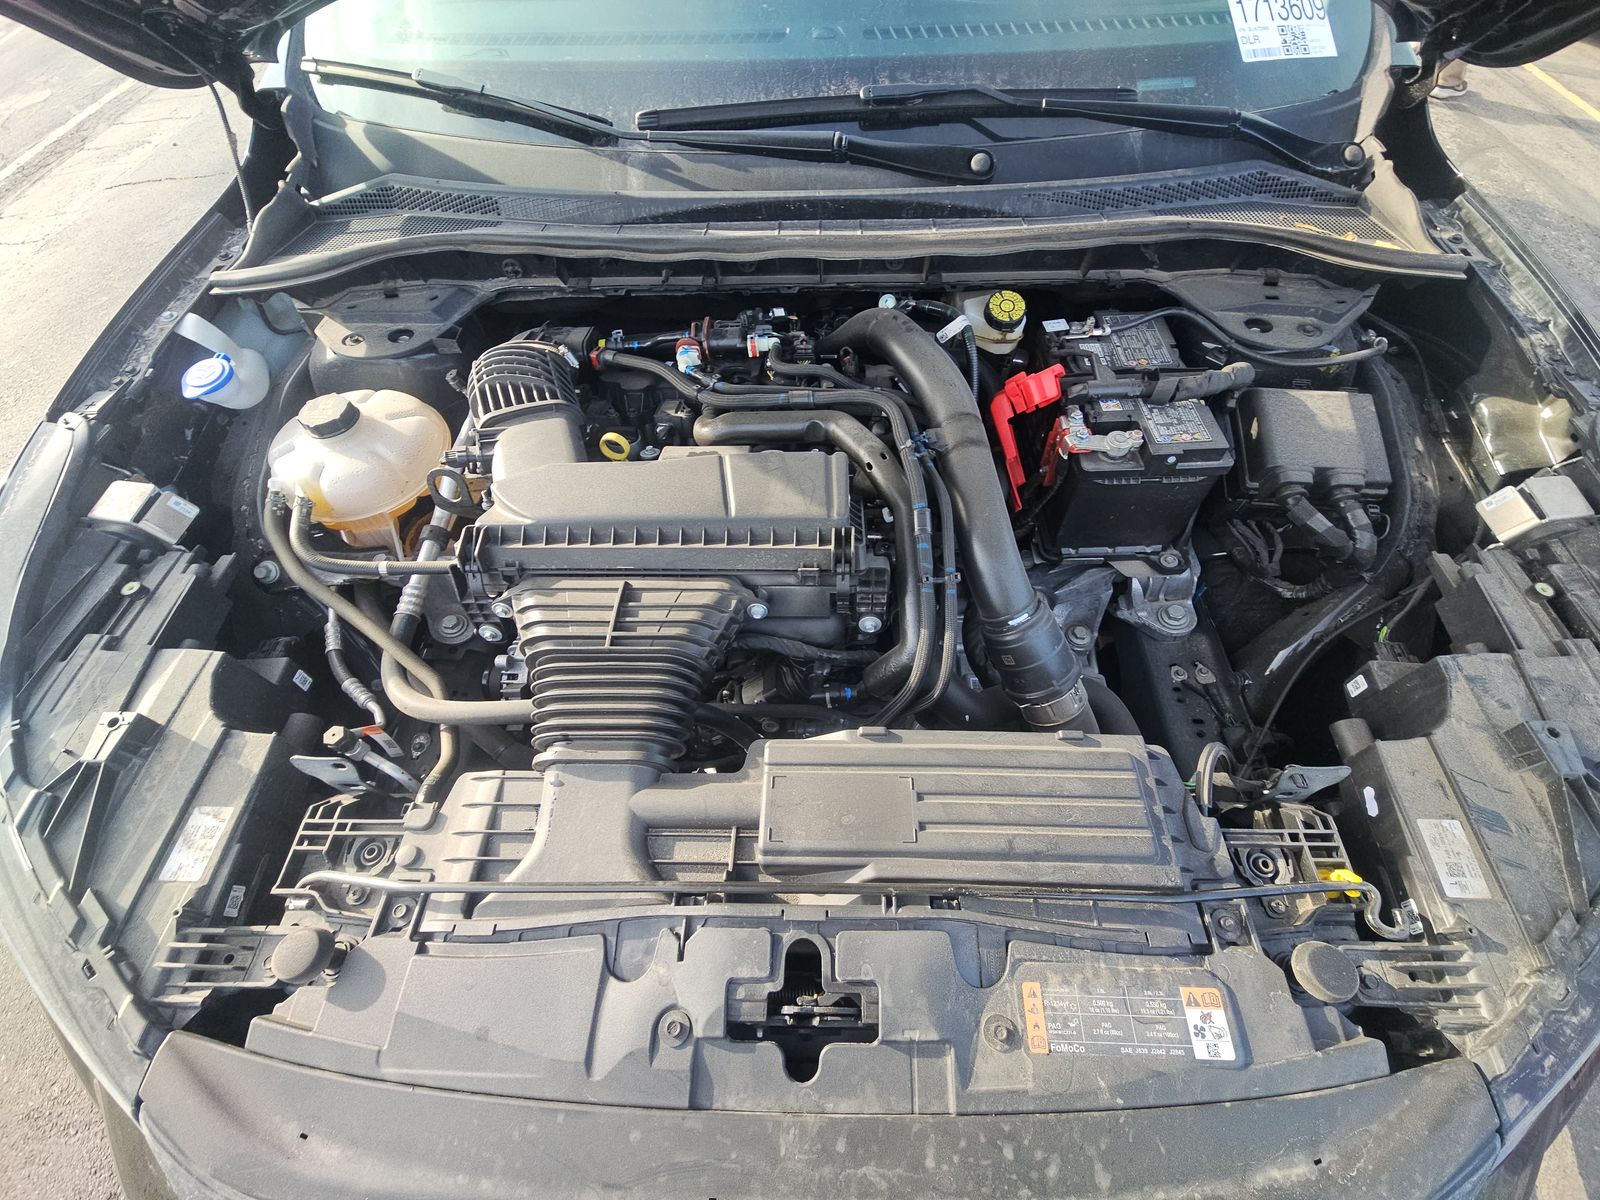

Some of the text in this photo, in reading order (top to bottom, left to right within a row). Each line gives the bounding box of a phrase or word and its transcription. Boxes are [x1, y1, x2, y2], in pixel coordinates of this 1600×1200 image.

[1236, 0, 1326, 22] 1713609
[1240, 35, 1261, 45] DLR
[1048, 1022, 1062, 1030] PAG
[1051, 1044, 1085, 1053] FoMoCo
